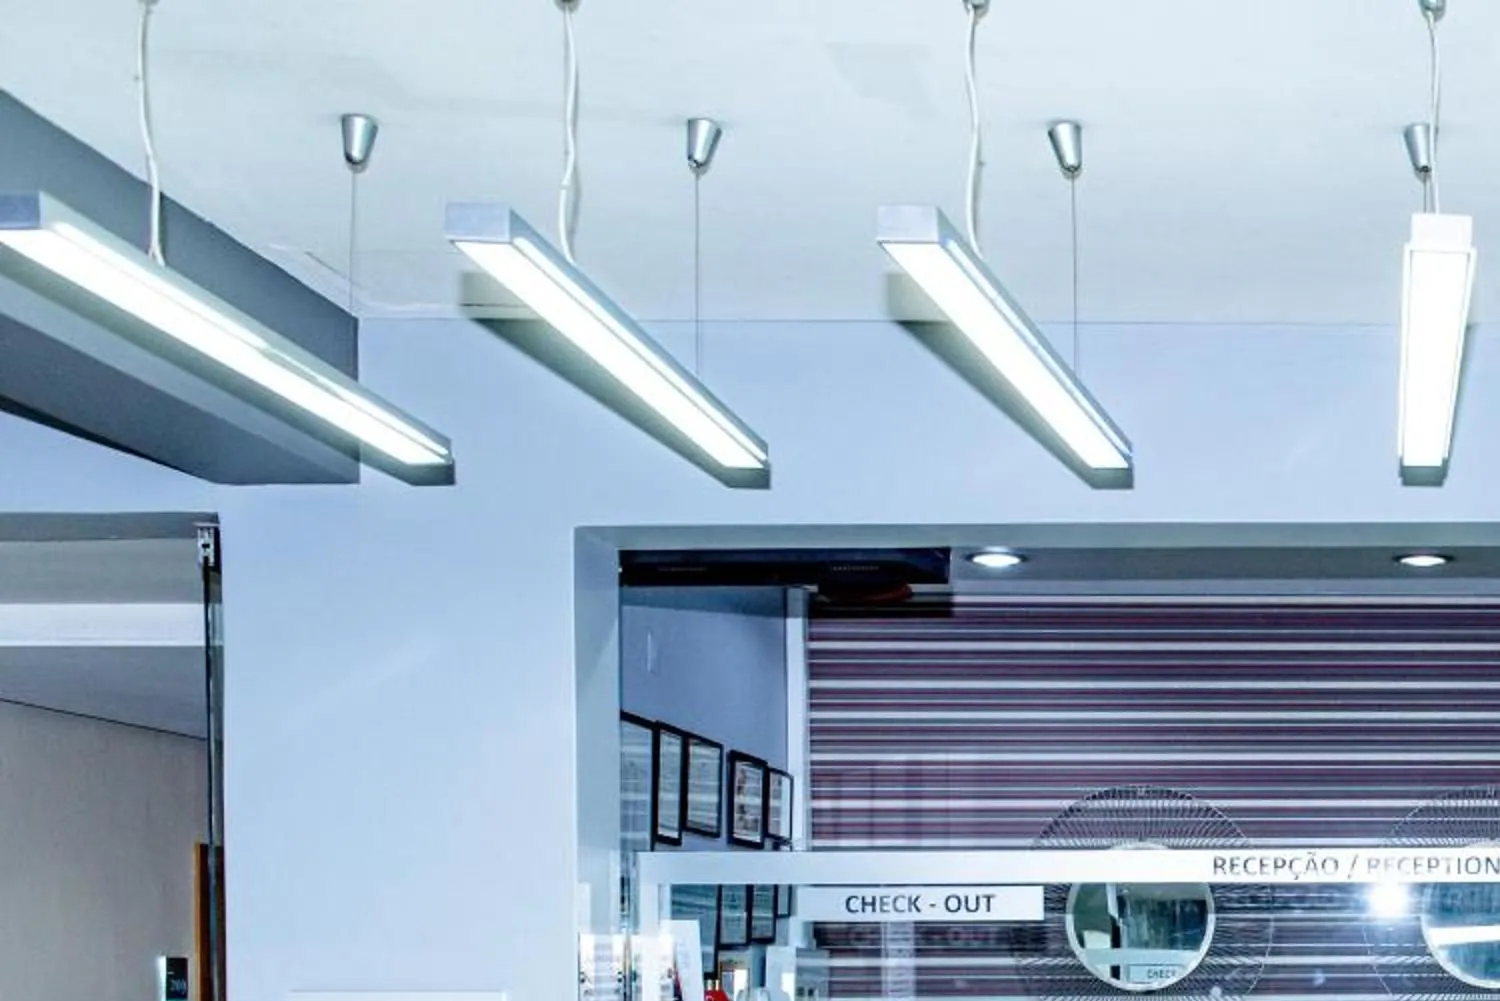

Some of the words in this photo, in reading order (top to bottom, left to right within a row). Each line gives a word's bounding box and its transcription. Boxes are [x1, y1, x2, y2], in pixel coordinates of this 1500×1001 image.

[1213, 852, 1339, 880] RECEPÇÃO
[1347, 855, 1358, 878] /
[1366, 856, 1500, 875] RECEPTION
[845, 894, 921, 914] CHECK
[944, 894, 996, 914] OUT
